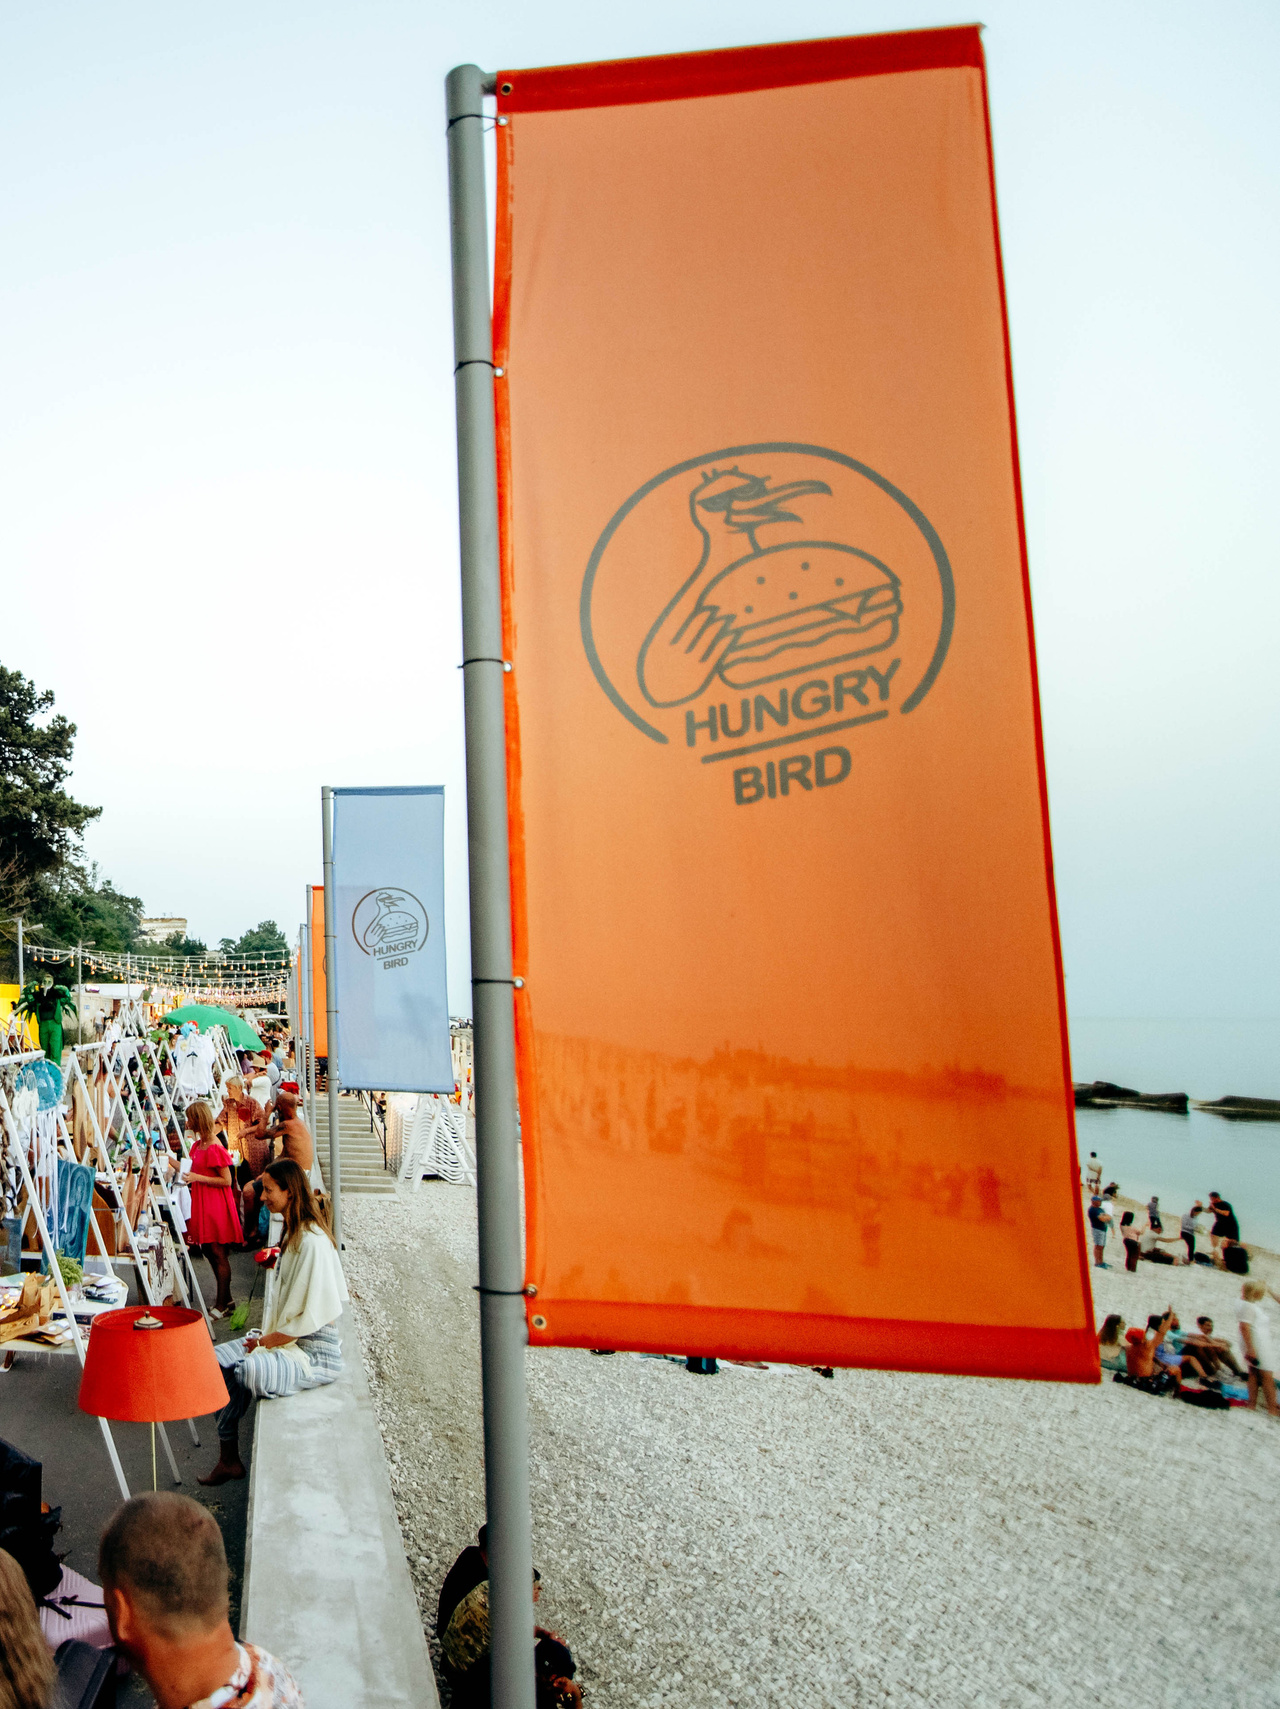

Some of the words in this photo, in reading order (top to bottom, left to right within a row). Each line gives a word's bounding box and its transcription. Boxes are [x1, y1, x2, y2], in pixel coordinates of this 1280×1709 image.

[685, 658, 901, 748] HUNGRY
[733, 746, 852, 806] BIRD
[373, 939, 418, 957] HUNGRY
[383, 957, 409, 970] BIRD
